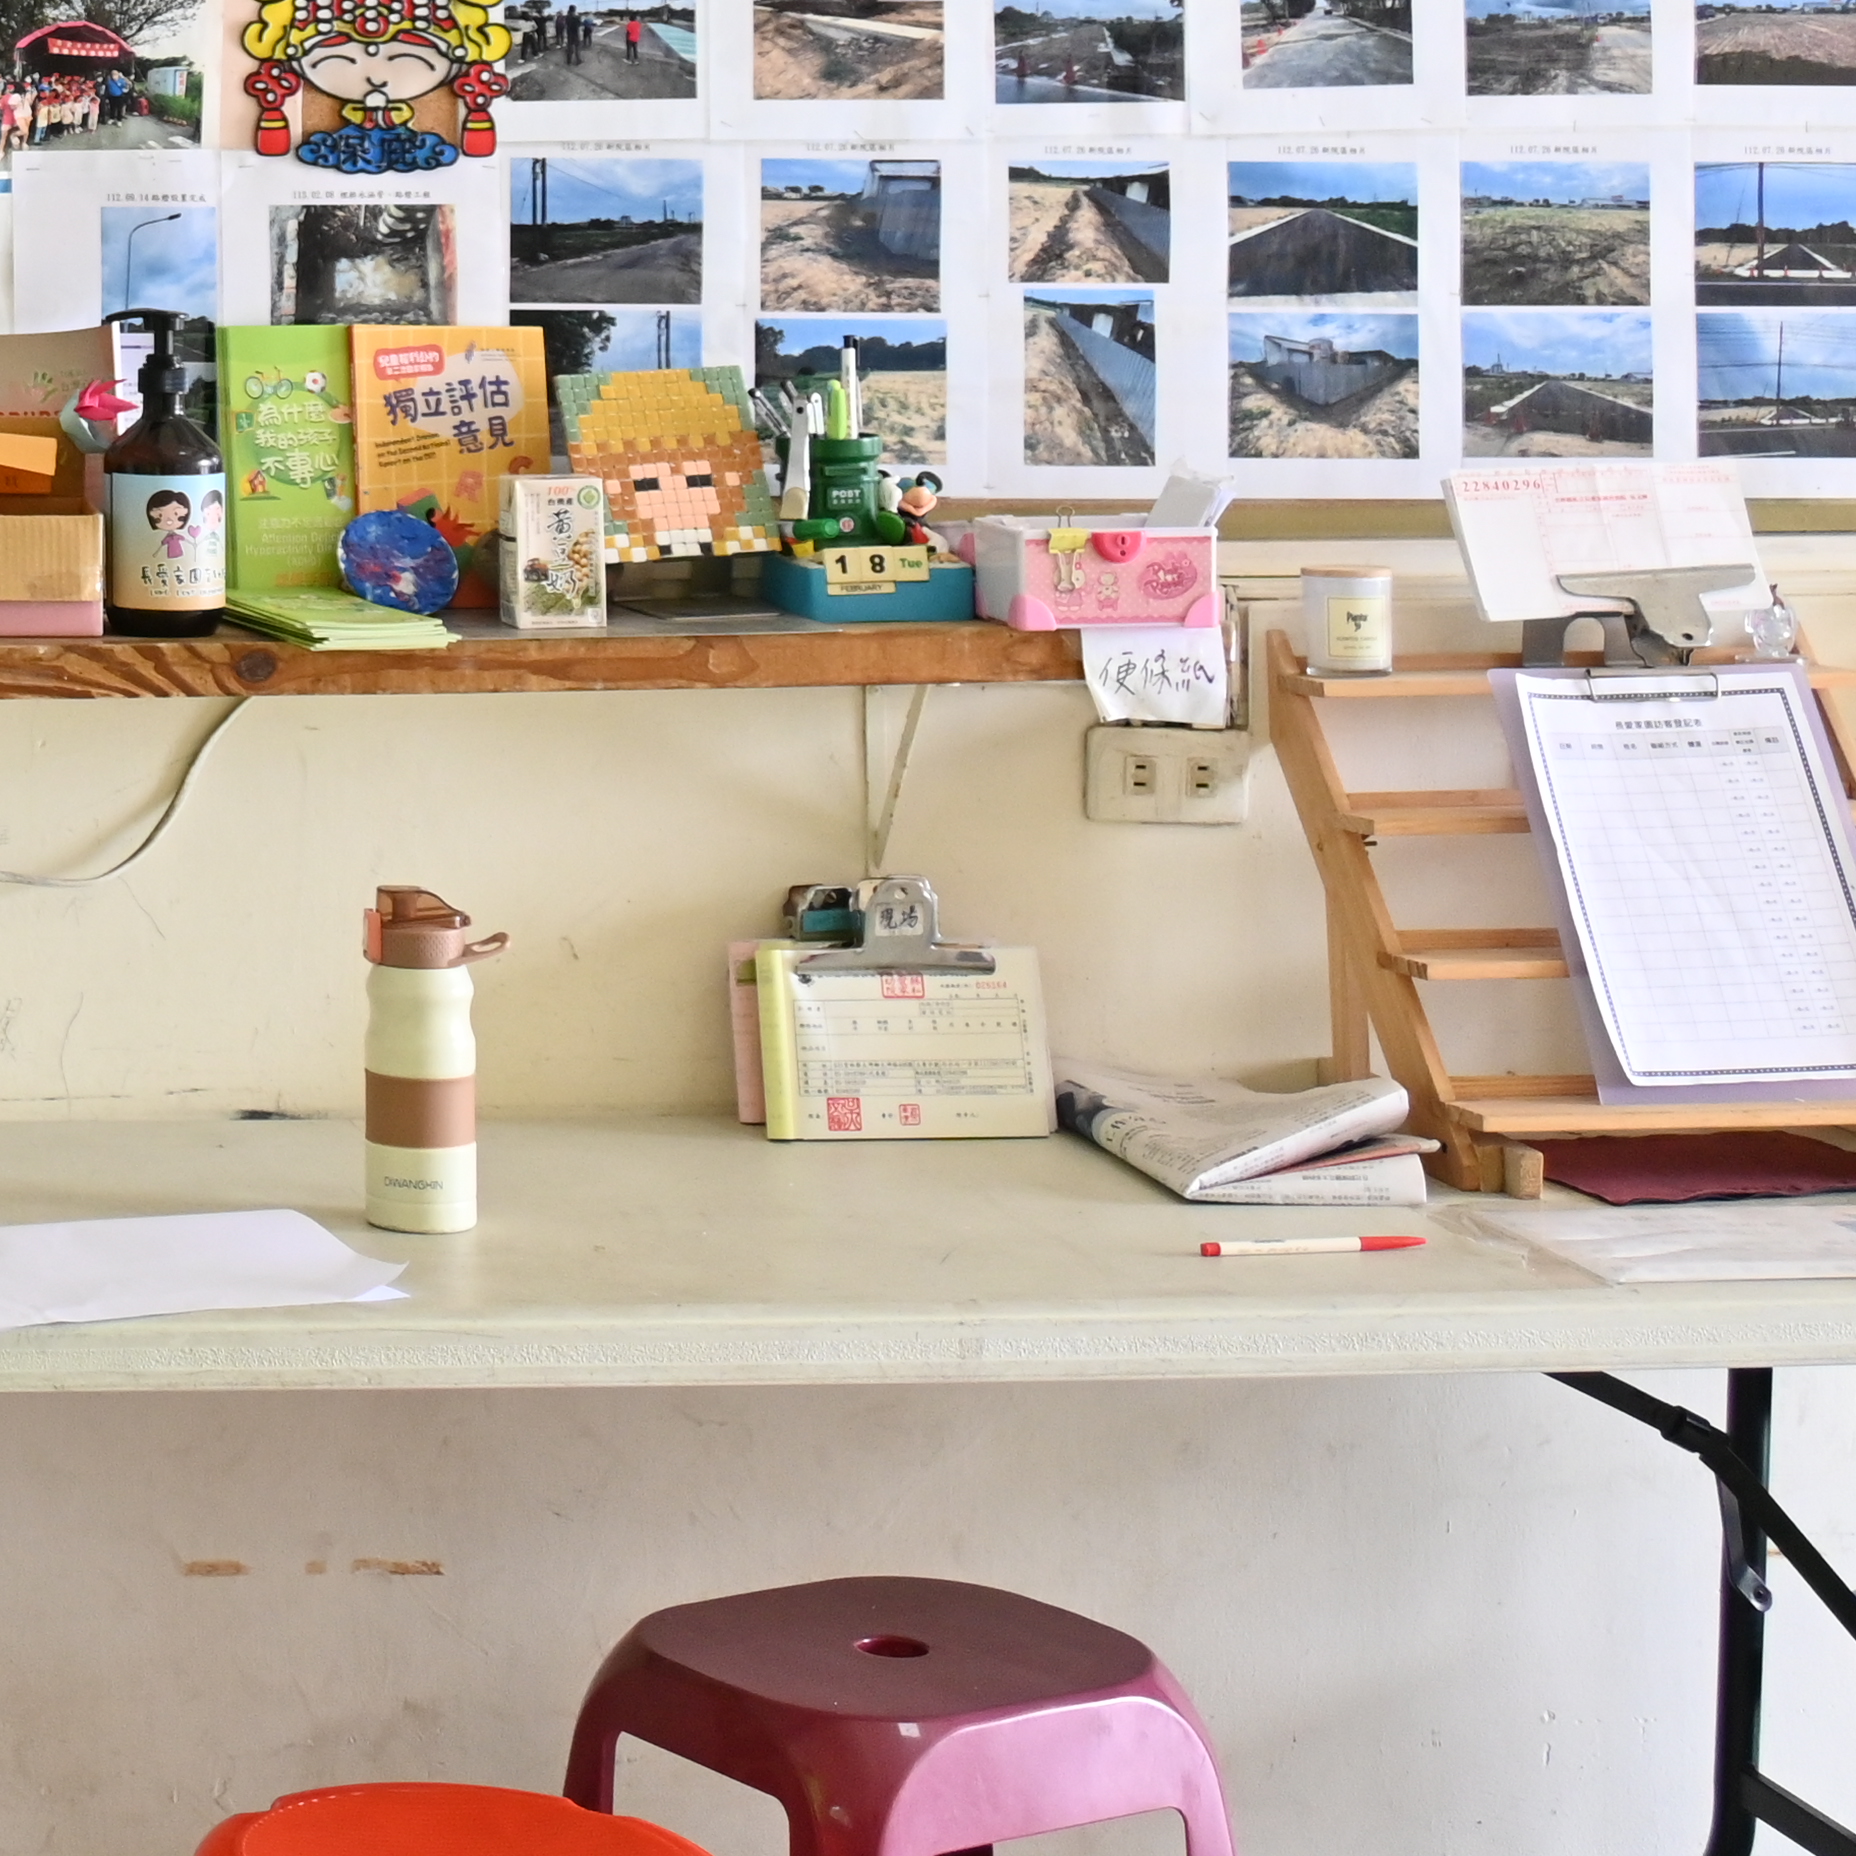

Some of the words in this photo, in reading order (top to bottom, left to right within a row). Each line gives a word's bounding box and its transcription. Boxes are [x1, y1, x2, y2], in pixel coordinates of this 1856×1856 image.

[383, 375, 510, 425] 獨立評估
[258, 401, 325, 426] 為什麼
[254, 429, 337, 449] 我的孩子
[453, 415, 514, 454] 意見
[261, 449, 338, 488] 不專心
[832, 490, 861, 498] POST
[1463, 479, 1541, 493] 22840296
[899, 558, 923, 569] Tue
[840, 583, 883, 592] FEBRUARY
[1100, 649, 1216, 693] 便條紙
[879, 905, 919, 930] 現場
